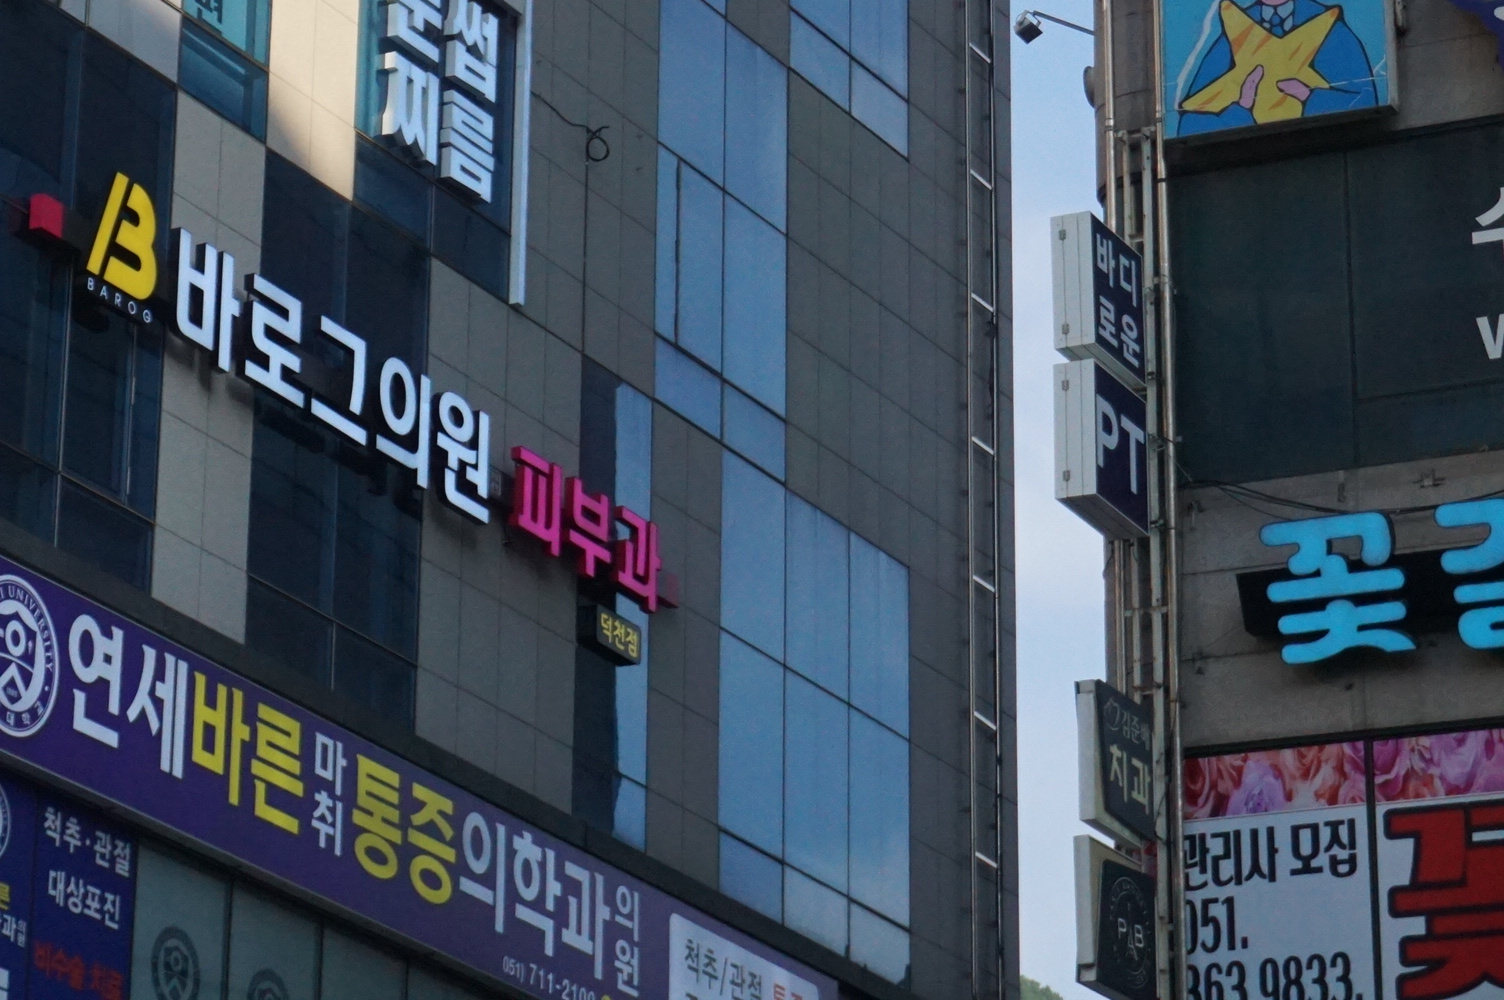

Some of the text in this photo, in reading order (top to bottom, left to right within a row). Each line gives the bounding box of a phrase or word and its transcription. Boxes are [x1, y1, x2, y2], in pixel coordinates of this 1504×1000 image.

[382, 50, 495, 203] 찌름
[87, 277, 152, 324] BAROG
[1096, 232, 1137, 308] 바디
[1098, 294, 1141, 369] 로운
[174, 227, 490, 526] 바로그의원
[1096, 393, 1147, 496] PT
[511, 446, 663, 613] 피부과
[600, 612, 639, 658] 덕천점
[1109, 743, 1151, 815] 치과
[1290, 817, 1359, 879] 모집
[47, 868, 122, 931] 대상포진
[502, 954, 525, 984] 051)
